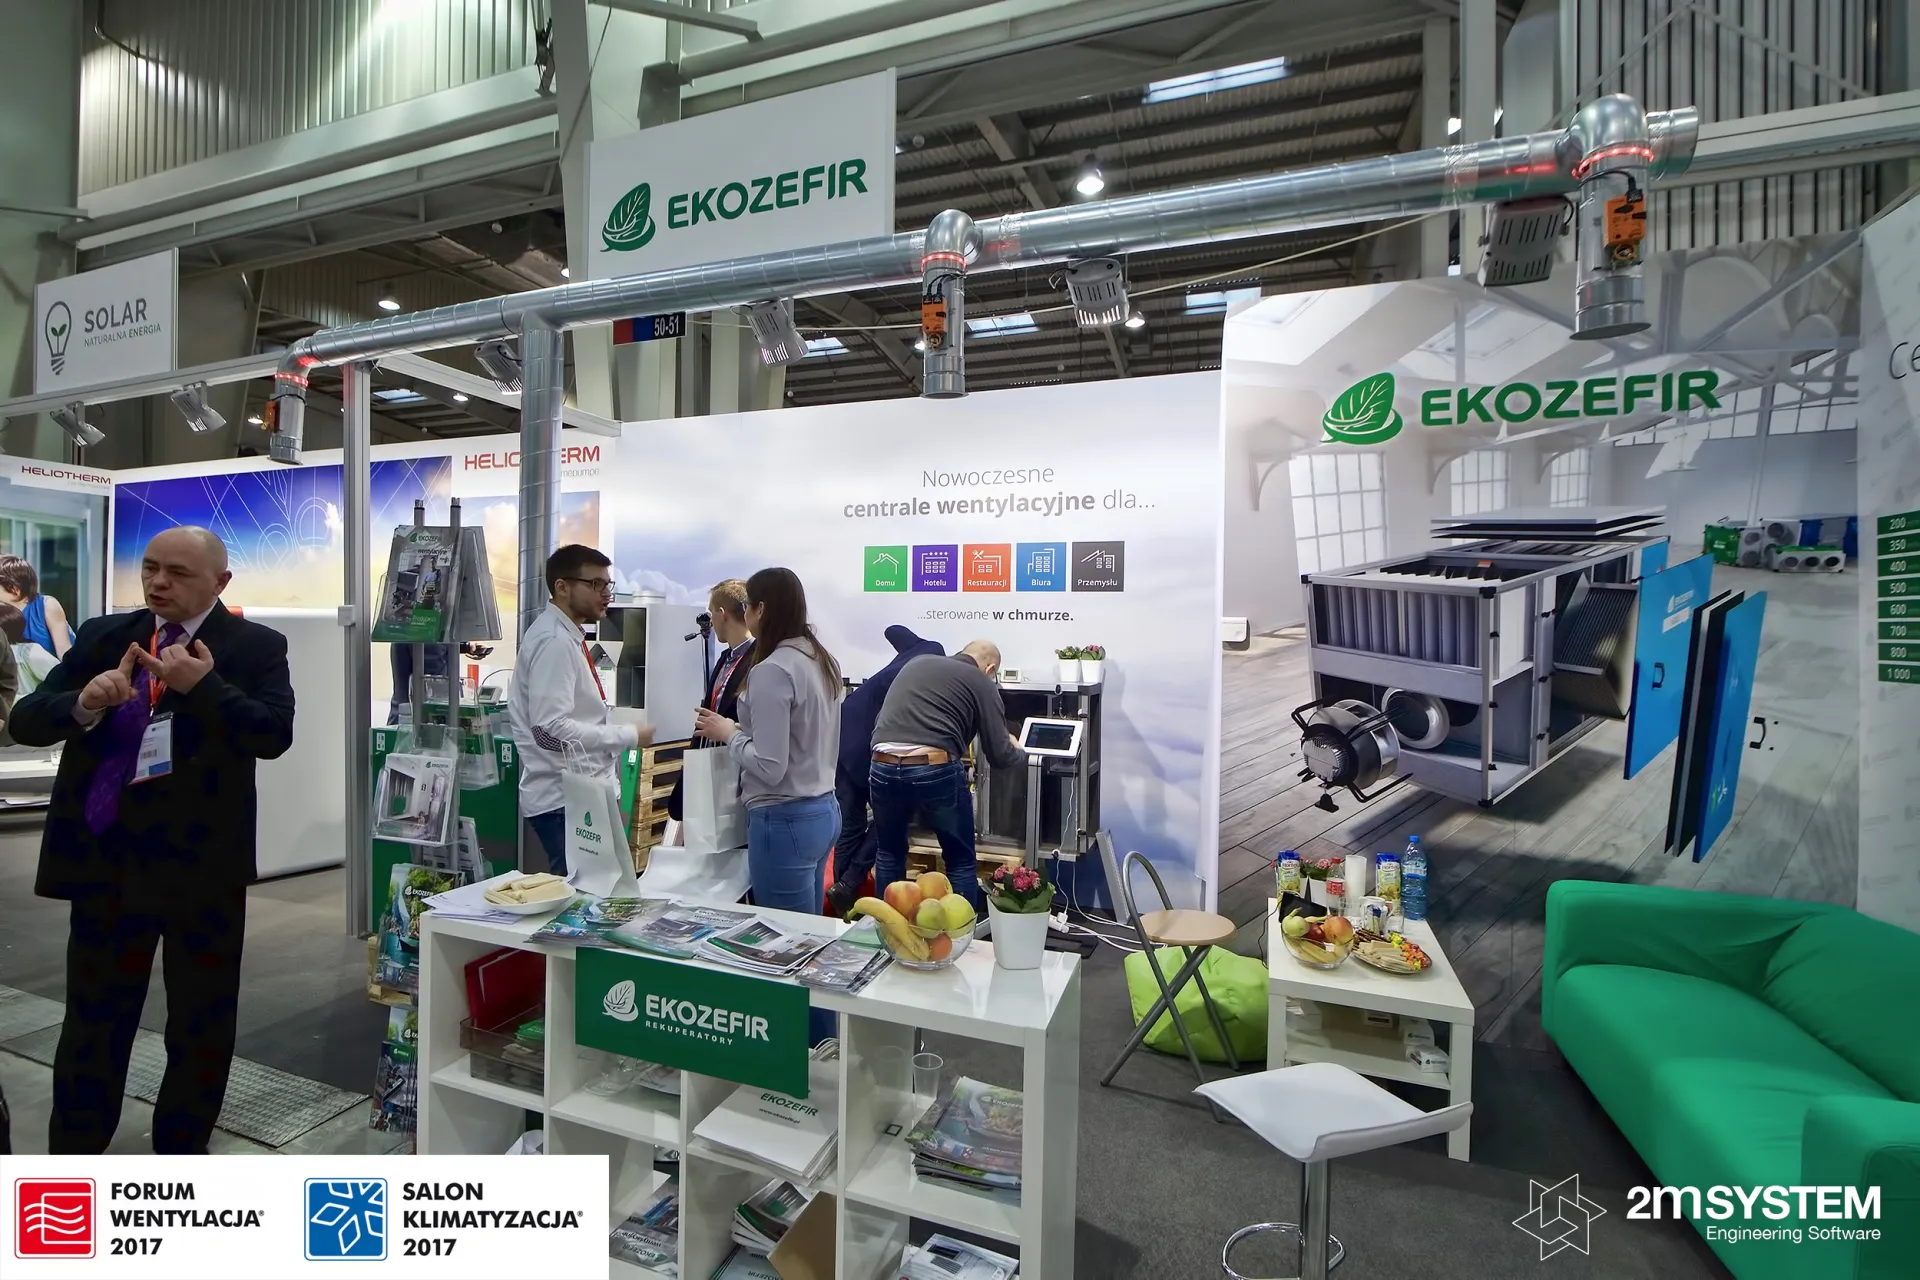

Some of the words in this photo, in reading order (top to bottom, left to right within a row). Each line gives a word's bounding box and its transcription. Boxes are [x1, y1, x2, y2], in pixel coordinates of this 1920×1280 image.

[667, 158, 868, 229] EKOZEFIR
[84, 297, 147, 333] SOLAR
[654, 314, 679, 337] 50-51
[84, 331, 127, 347] NATURALNA
[128, 323, 161, 339] ENERGIA
[1421, 369, 1723, 427] EKOZEFIR
[21, 465, 111, 485] HELIOTHERM
[922, 467, 1055, 488] Nowoczesne
[843, 497, 931, 518] centrale
[936, 491, 1096, 518] wentylacyjne
[1889, 517, 1907, 531] 200
[1889, 538, 1907, 552] 350
[1889, 560, 1907, 573] 400
[875, 579, 895, 587] Domu
[923, 578, 947, 587] Hotelu
[967, 578, 1007, 588] Restauracji
[1031, 578, 1051, 587] Biura
[1077, 578, 1118, 588] Przemysłu
[1889, 581, 1907, 594] 500
[917, 608, 989, 621] ...sterowane
[992, 611, 1004, 621] w
[1008, 608, 1074, 621] chmurze.
[1890, 603, 1907, 615] 600
[1890, 625, 1907, 637] 700
[1890, 646, 1907, 658] 800
[576, 827, 602, 844] EKOZEFIR
[645, 993, 770, 1042] EKOZEFIR
[645, 1020, 733, 1046] REKUPERATORY
[760, 1092, 819, 1117] EKOZEFIR
